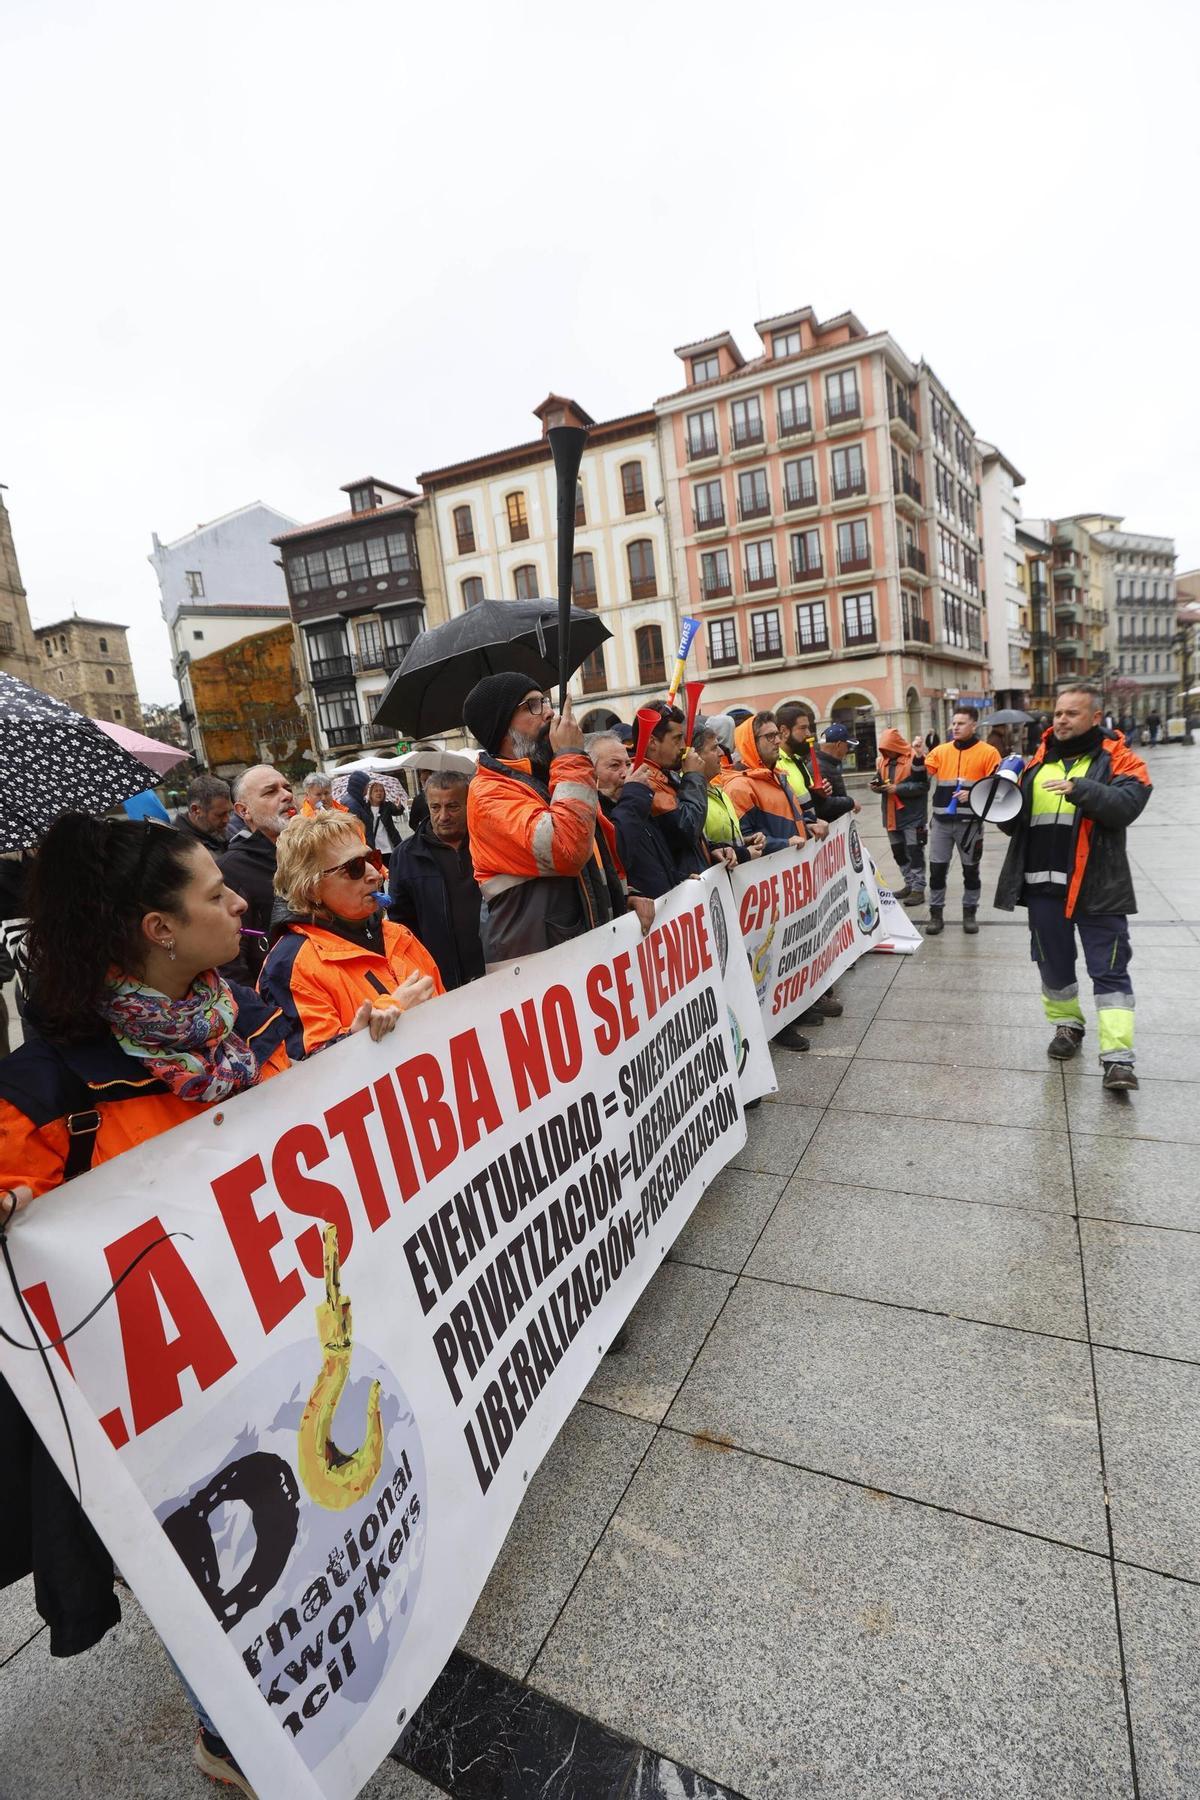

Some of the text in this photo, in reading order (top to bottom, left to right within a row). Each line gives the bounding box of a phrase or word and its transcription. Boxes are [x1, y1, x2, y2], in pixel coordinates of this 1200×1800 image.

[739, 874, 780, 936] CPE
[777, 931, 821, 977] CONTRA LA
[772, 965, 809, 1015] STOP
[210, 1027, 503, 1336] ESTIBA
[500, 984, 583, 1112] NO
[586, 951, 640, 1056] SE
[637, 903, 713, 1020] VENDE
[402, 1091, 602, 1316] EVENTUALIDAD
[618, 986, 718, 1118] SINIESTRALIDAD
[242, 1449, 413, 1679] rnational
